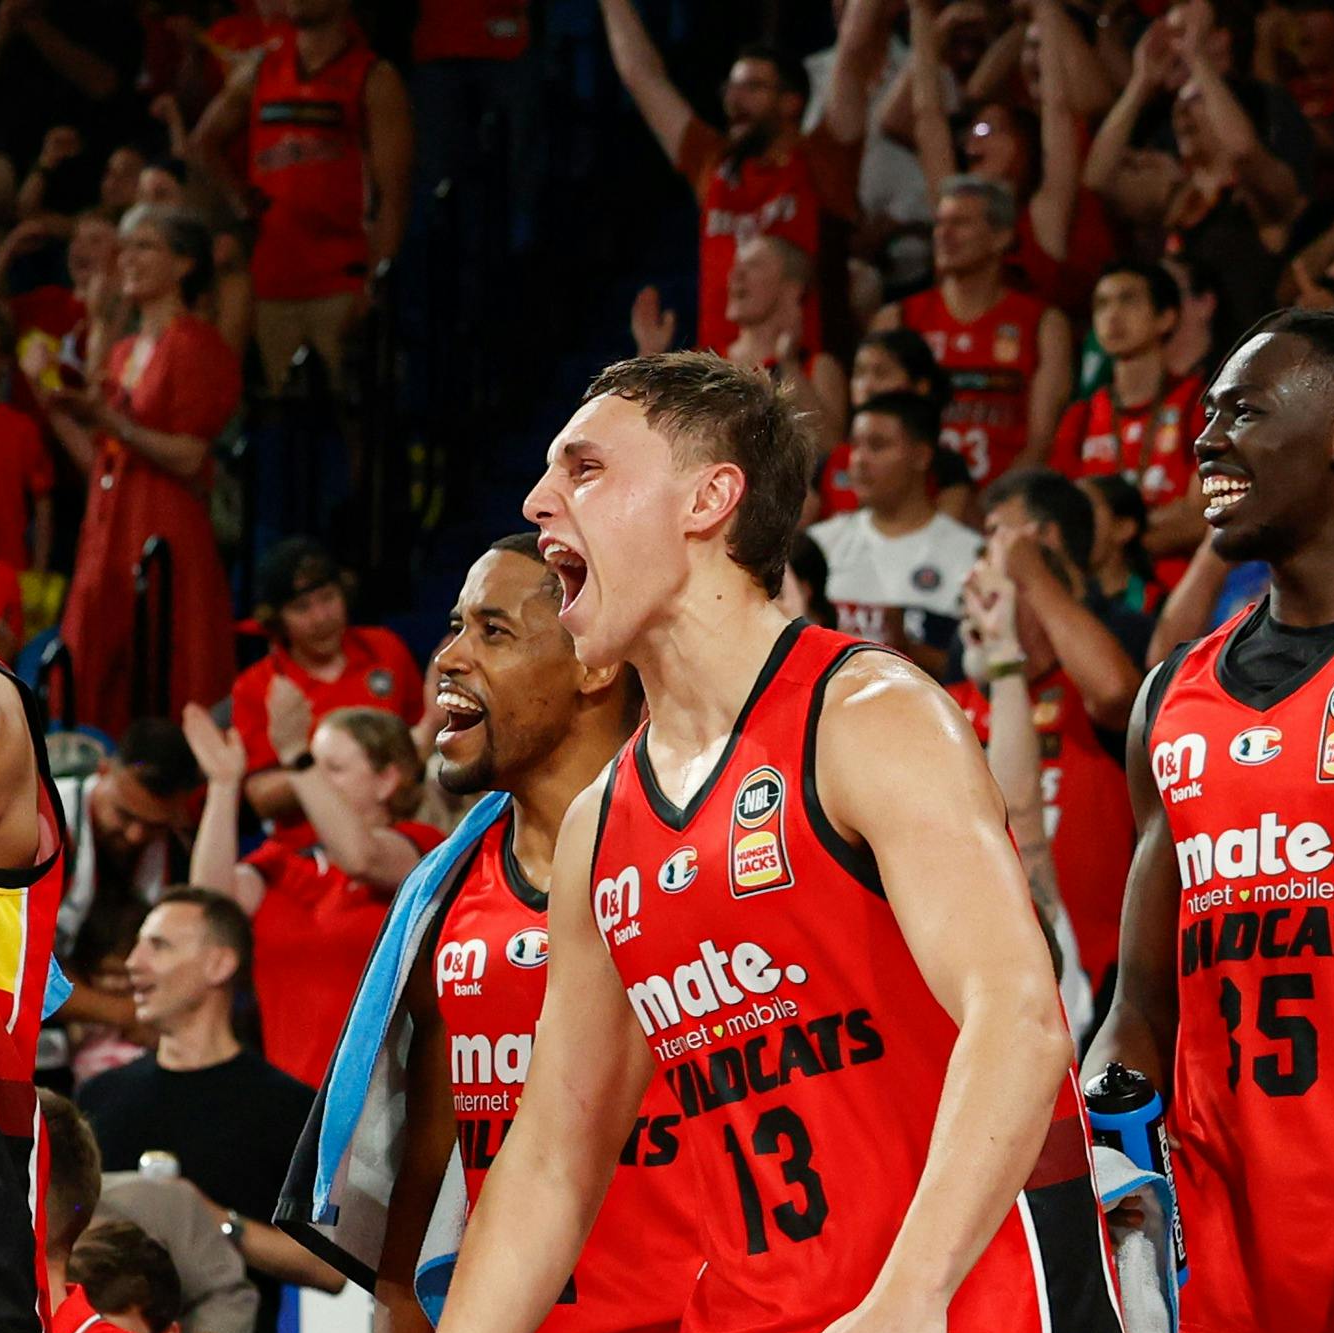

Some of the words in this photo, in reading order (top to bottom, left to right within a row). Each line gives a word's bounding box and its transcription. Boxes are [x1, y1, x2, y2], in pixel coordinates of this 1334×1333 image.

[743, 784, 771, 814] NBL
[1171, 781, 1203, 803] bank
[736, 844, 775, 861] HUNGRY
[737, 855, 777, 876] JACK'S
[614, 920, 642, 946] bank
[454, 981, 483, 997] bank
[626, 939, 809, 1037] mate.
[726, 996, 798, 1037] mobile
[724, 1105, 829, 1256] 13
